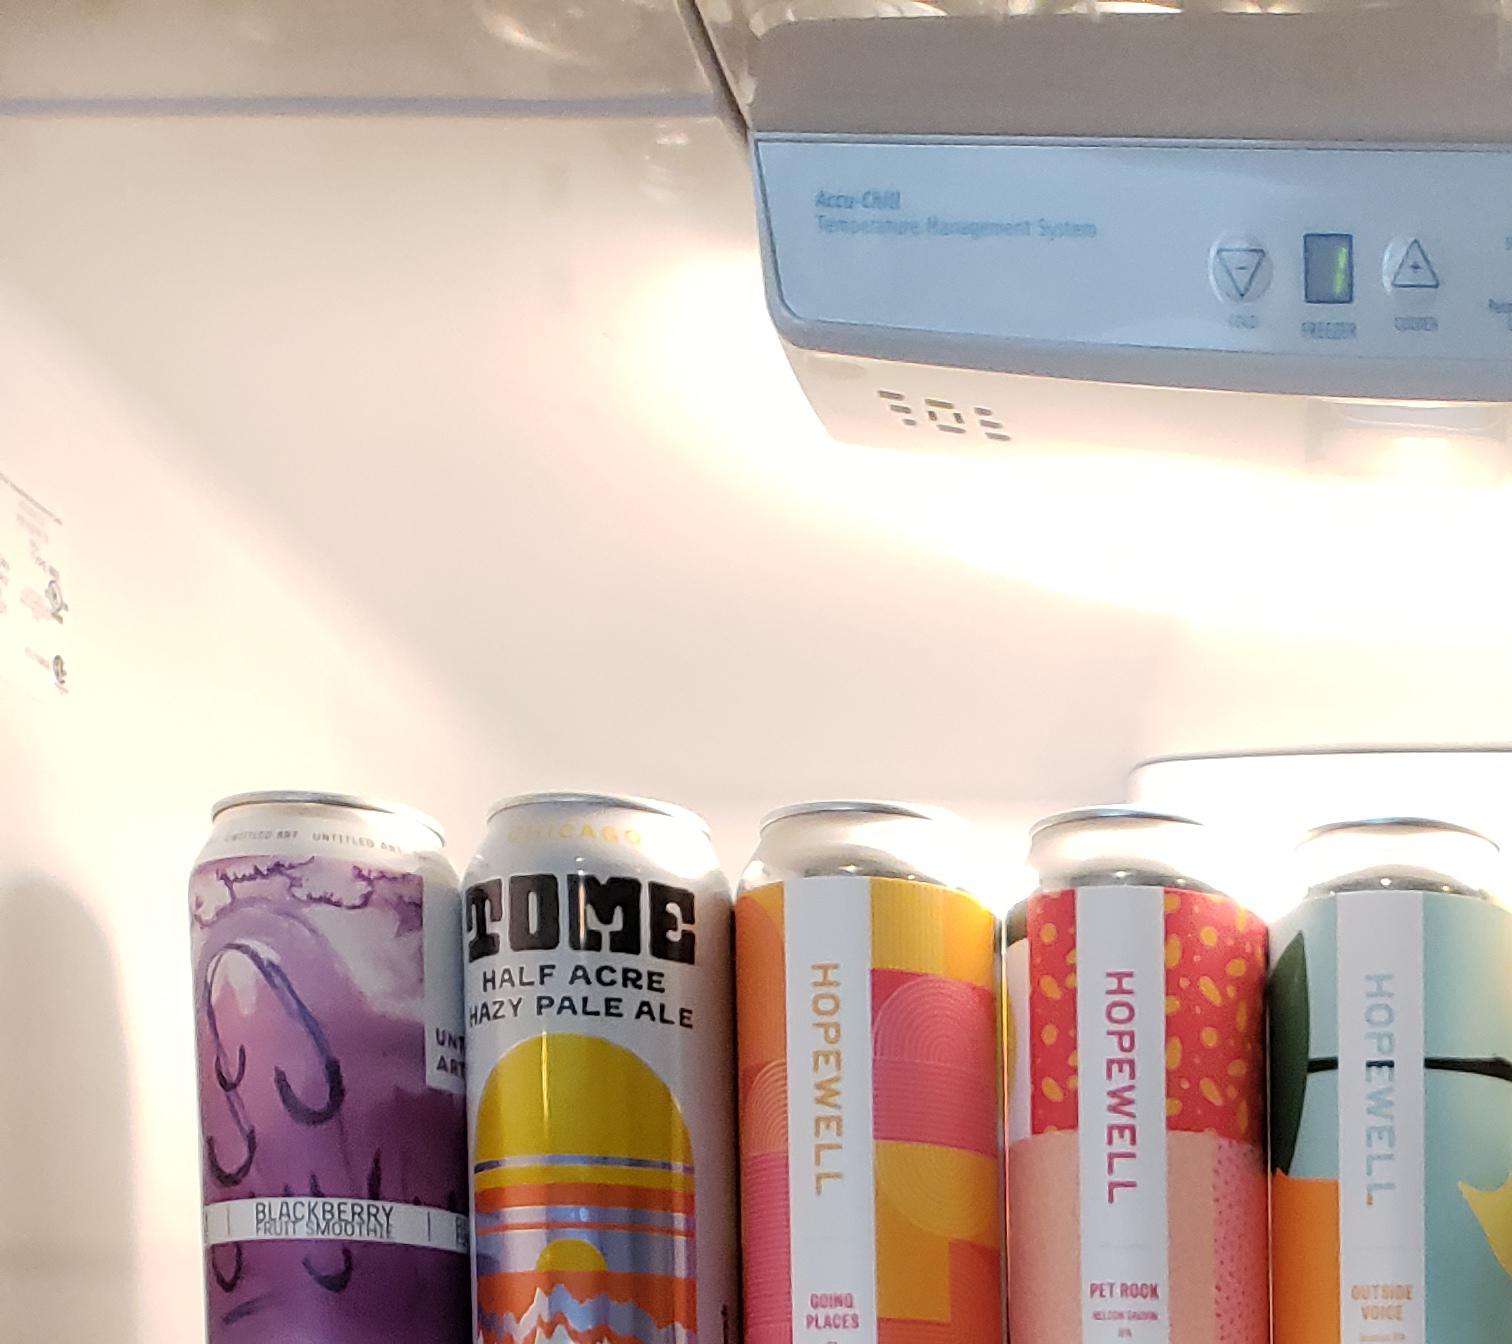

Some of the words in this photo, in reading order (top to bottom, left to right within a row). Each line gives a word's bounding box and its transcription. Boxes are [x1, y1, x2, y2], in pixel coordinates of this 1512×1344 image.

[815, 215, 920, 237] Temperature
[924, 217, 1032, 240] Management
[1035, 219, 1097, 240] System
[468, 874, 696, 964] TOME
[482, 964, 556, 993] HALF
[568, 964, 666, 993] ACRE
[469, 1000, 521, 1028] HAZY
[536, 996, 623, 1020] PALE
[634, 1003, 694, 1029] ALE
[810, 961, 845, 1196] HOPEWELL
[1104, 970, 1138, 1204] HOPEWELL
[1364, 973, 1397, 1206] HOPEWELL
[255, 1201, 395, 1228] BLACKBERRY
[1089, 1282, 1116, 1300] PET
[1120, 1282, 1160, 1300] ROCK
[1350, 1284, 1413, 1301] OUTSIDE
[805, 1313, 860, 1331] PLACES
[1361, 1305, 1405, 1322] VOICE
